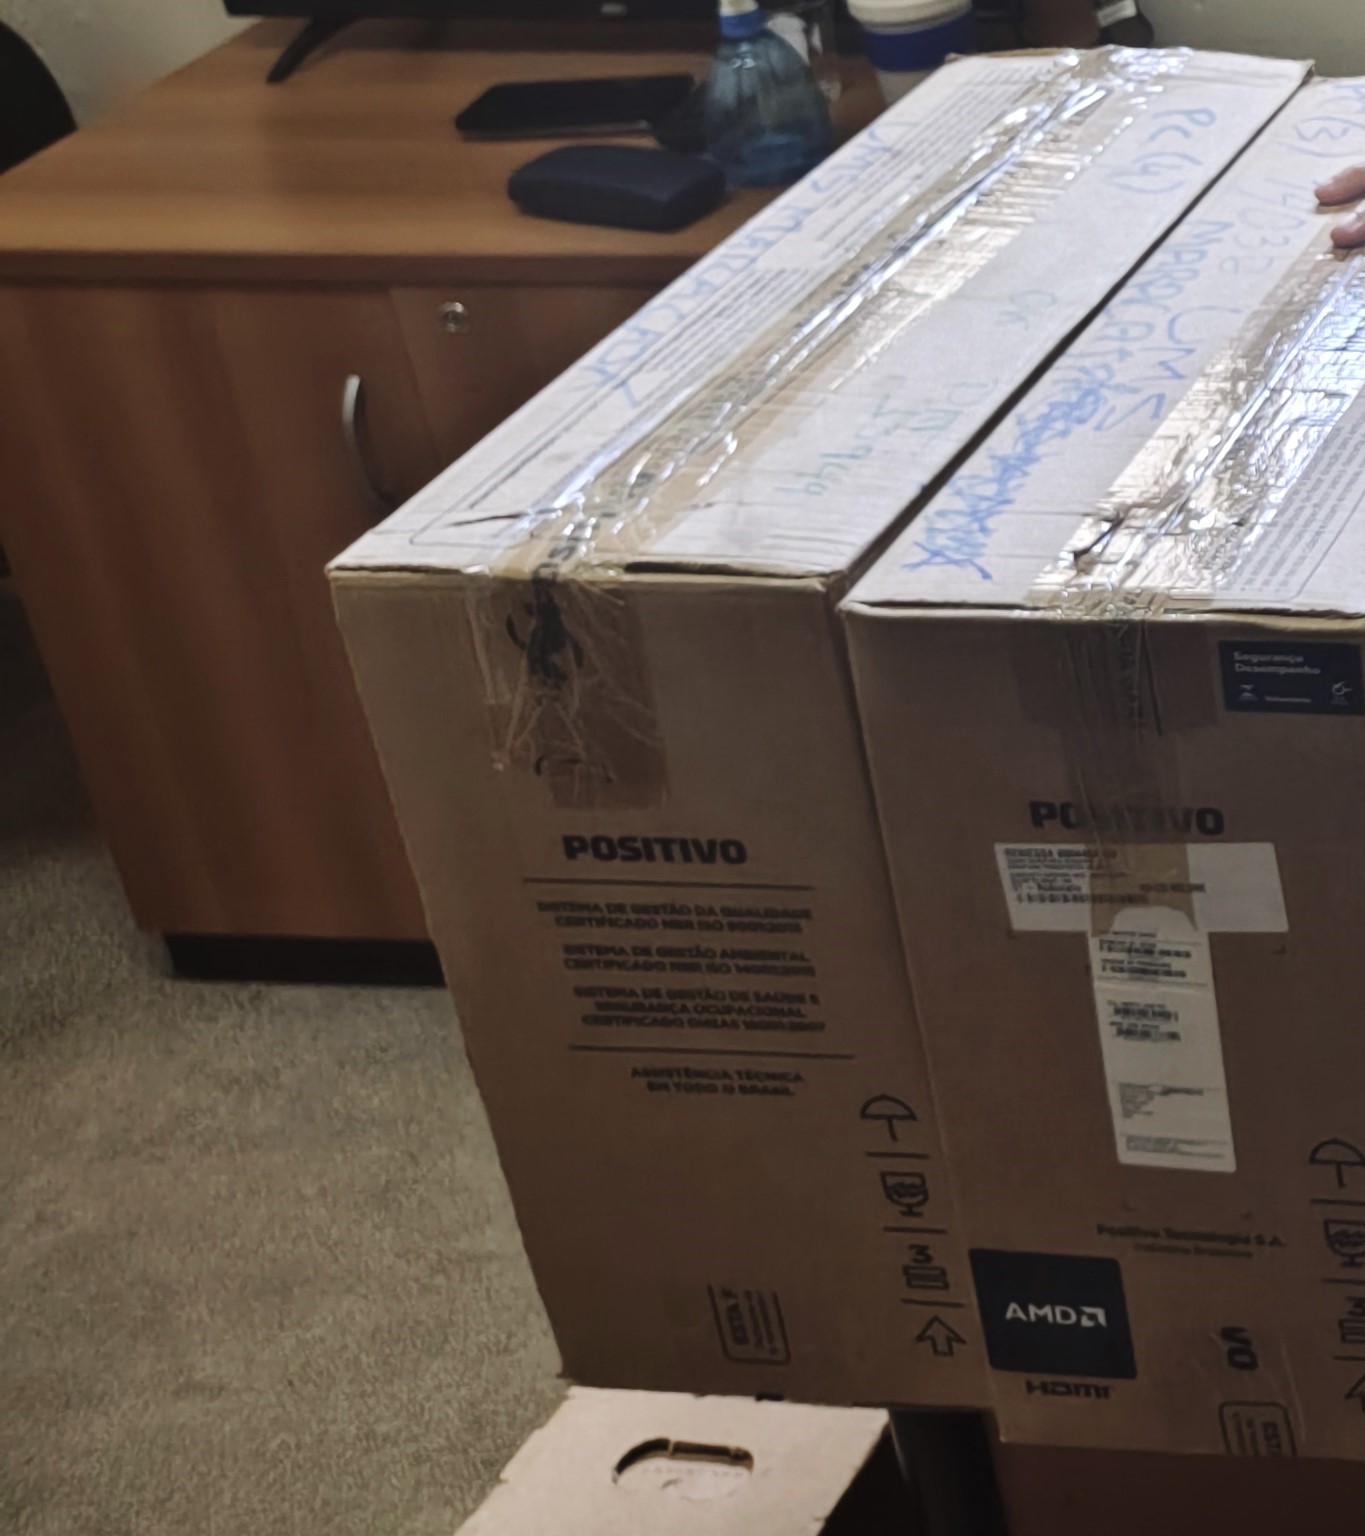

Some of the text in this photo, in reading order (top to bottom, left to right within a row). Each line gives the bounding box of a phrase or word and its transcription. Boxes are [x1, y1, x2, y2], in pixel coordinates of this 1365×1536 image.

[1149, 107, 1217, 143] PC
[1234, 662, 1321, 676] Desempenho
[562, 834, 748, 864] POSITIVO
[607, 902, 627, 914] DE
[695, 905, 719, 918] DA
[631, 944, 652, 957] DE
[642, 987, 663, 1000] DE
[729, 990, 750, 1002] DE
[908, 1243, 933, 1264] 3
[1005, 1301, 1077, 1326] AMD
